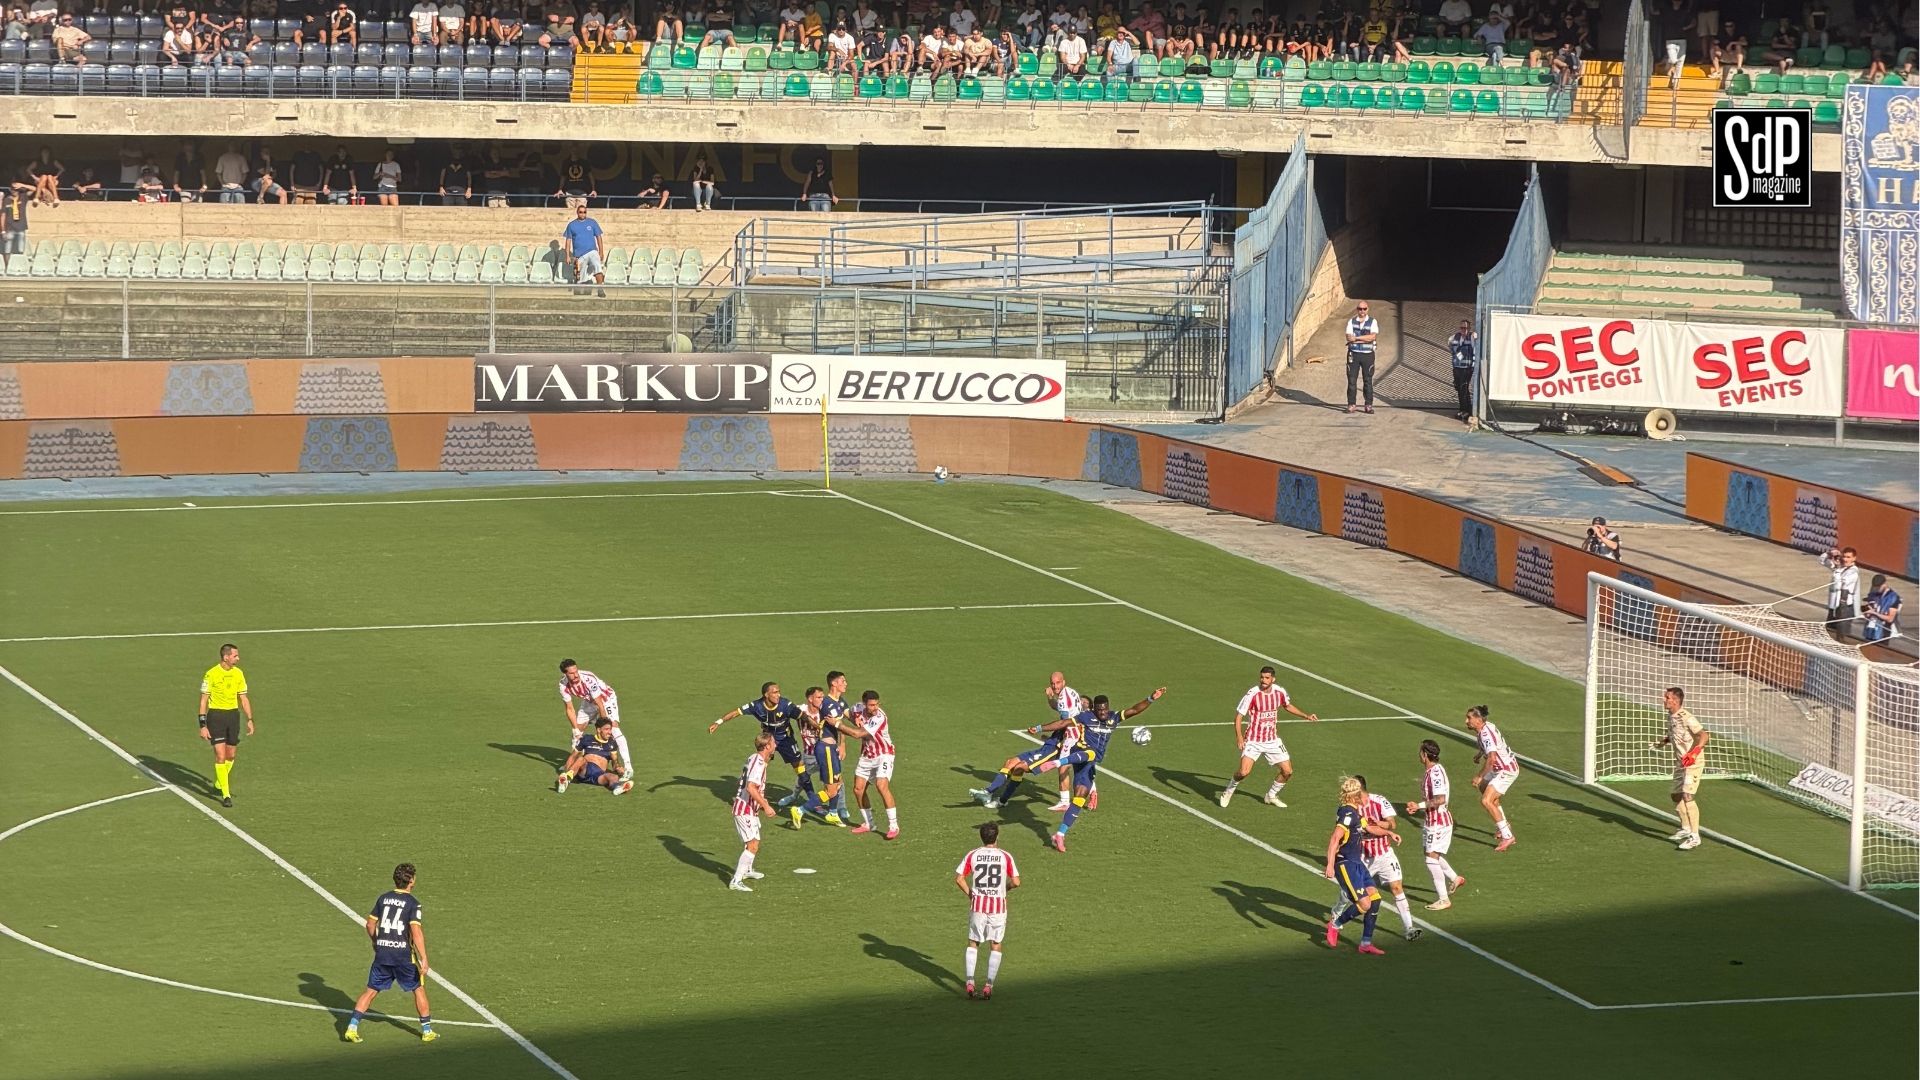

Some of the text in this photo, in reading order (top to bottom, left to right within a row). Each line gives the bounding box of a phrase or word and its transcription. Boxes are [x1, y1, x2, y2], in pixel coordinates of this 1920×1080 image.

[1876, 177, 1919, 204] H
[1521, 320, 1639, 379] SEC
[1693, 330, 1811, 389] SEC
[476, 364, 769, 402] MARKUP
[837, 370, 1046, 403] BERTUCCO
[1527, 367, 1642, 399] PONTEGGI
[1718, 379, 1803, 407] EVENTS
[774, 397, 822, 406] MAZDA
[1798, 768, 1868, 798] QUIGIOC
[975, 864, 1001, 887] 28
[380, 906, 405, 935] 44
